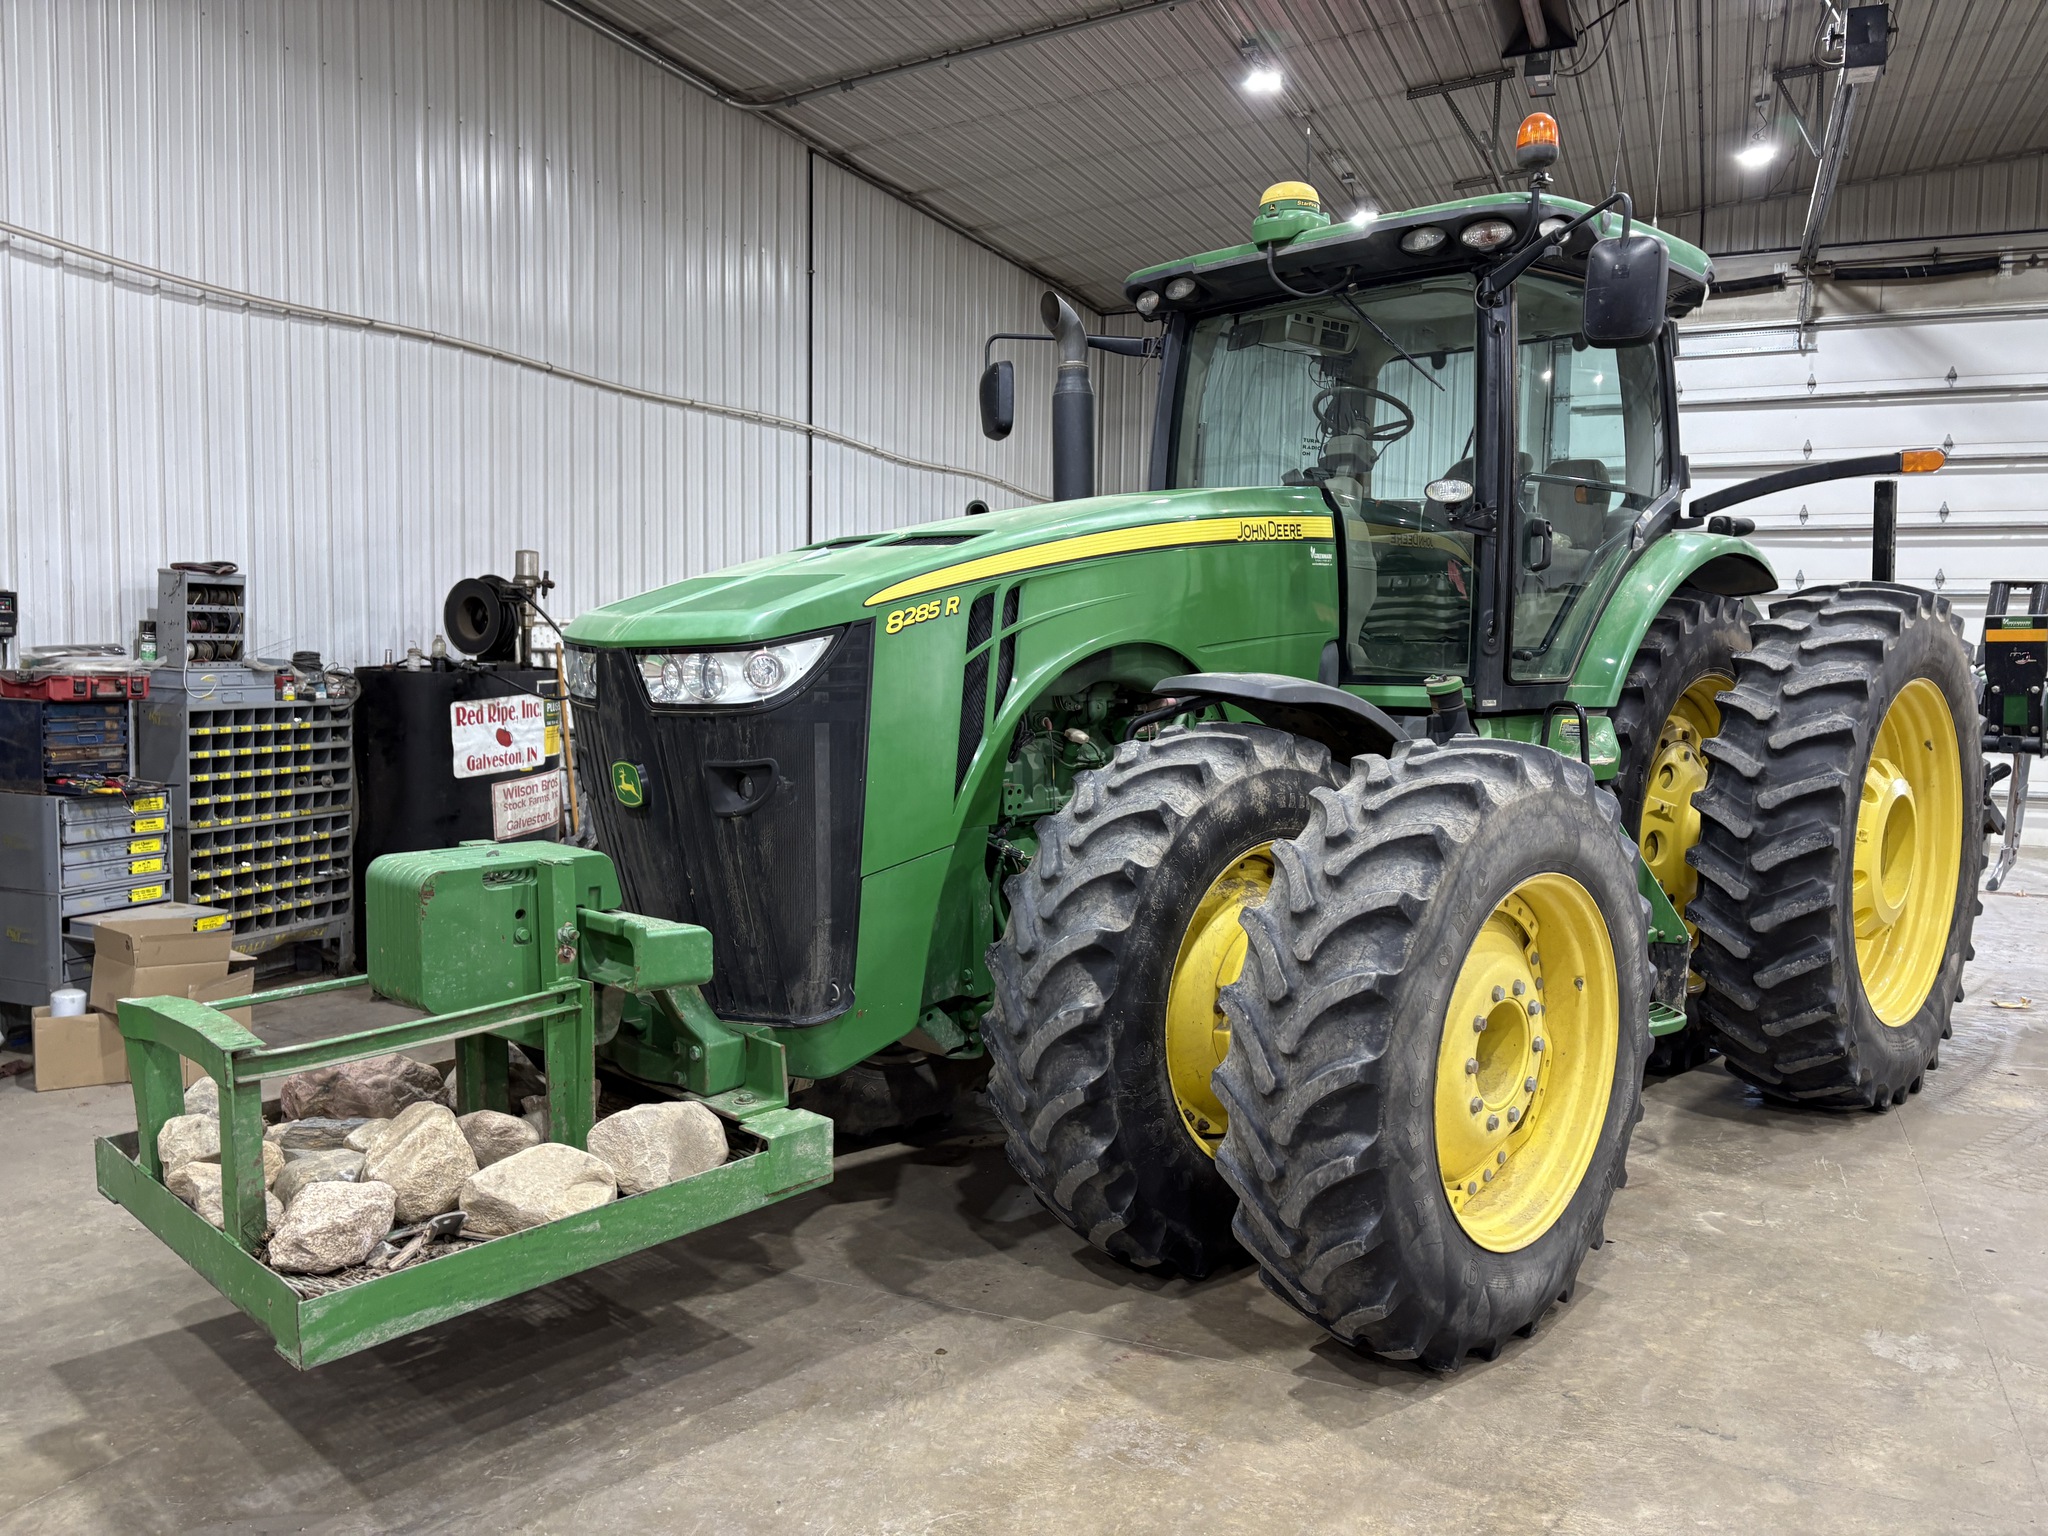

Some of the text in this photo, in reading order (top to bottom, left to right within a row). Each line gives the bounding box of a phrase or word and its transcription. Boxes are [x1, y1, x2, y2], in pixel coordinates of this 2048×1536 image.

[885, 595, 962, 635] 8285 R
[456, 699, 542, 726] Red Ripe, Inc.
[466, 746, 538, 772] Galveston, IN
[503, 783, 538, 800] Wilson
[503, 799, 526, 812] Stock
[506, 812, 551, 831] Galveston,
